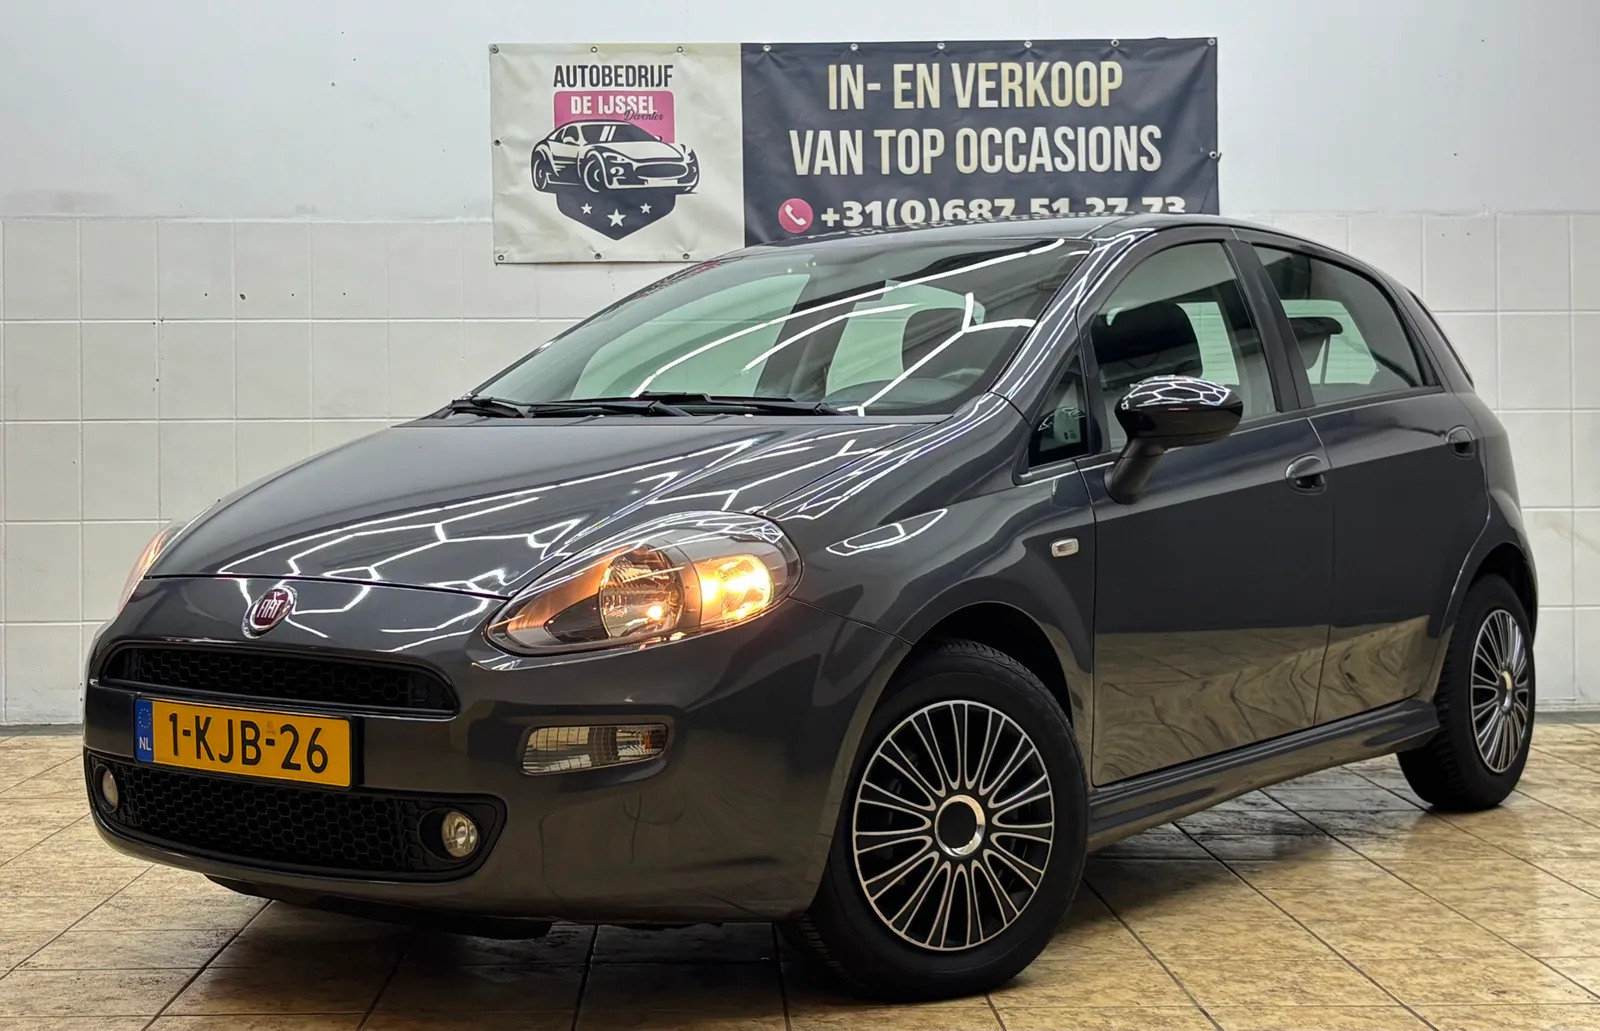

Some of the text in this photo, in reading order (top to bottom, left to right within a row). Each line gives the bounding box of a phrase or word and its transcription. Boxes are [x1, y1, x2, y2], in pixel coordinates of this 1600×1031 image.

[553, 64, 674, 88] AUTOBEDRIJF
[828, 60, 1124, 110] IN- EN VERKOOP
[570, 95, 658, 115] DE IJSSEL
[623, 109, 664, 121] Deventer
[789, 125, 1162, 175] VAN TOP OCCASIONS
[256, 598, 284, 619] FIAT
[138, 736, 152, 751] NL
[168, 712, 328, 774] 1-KJB-26
